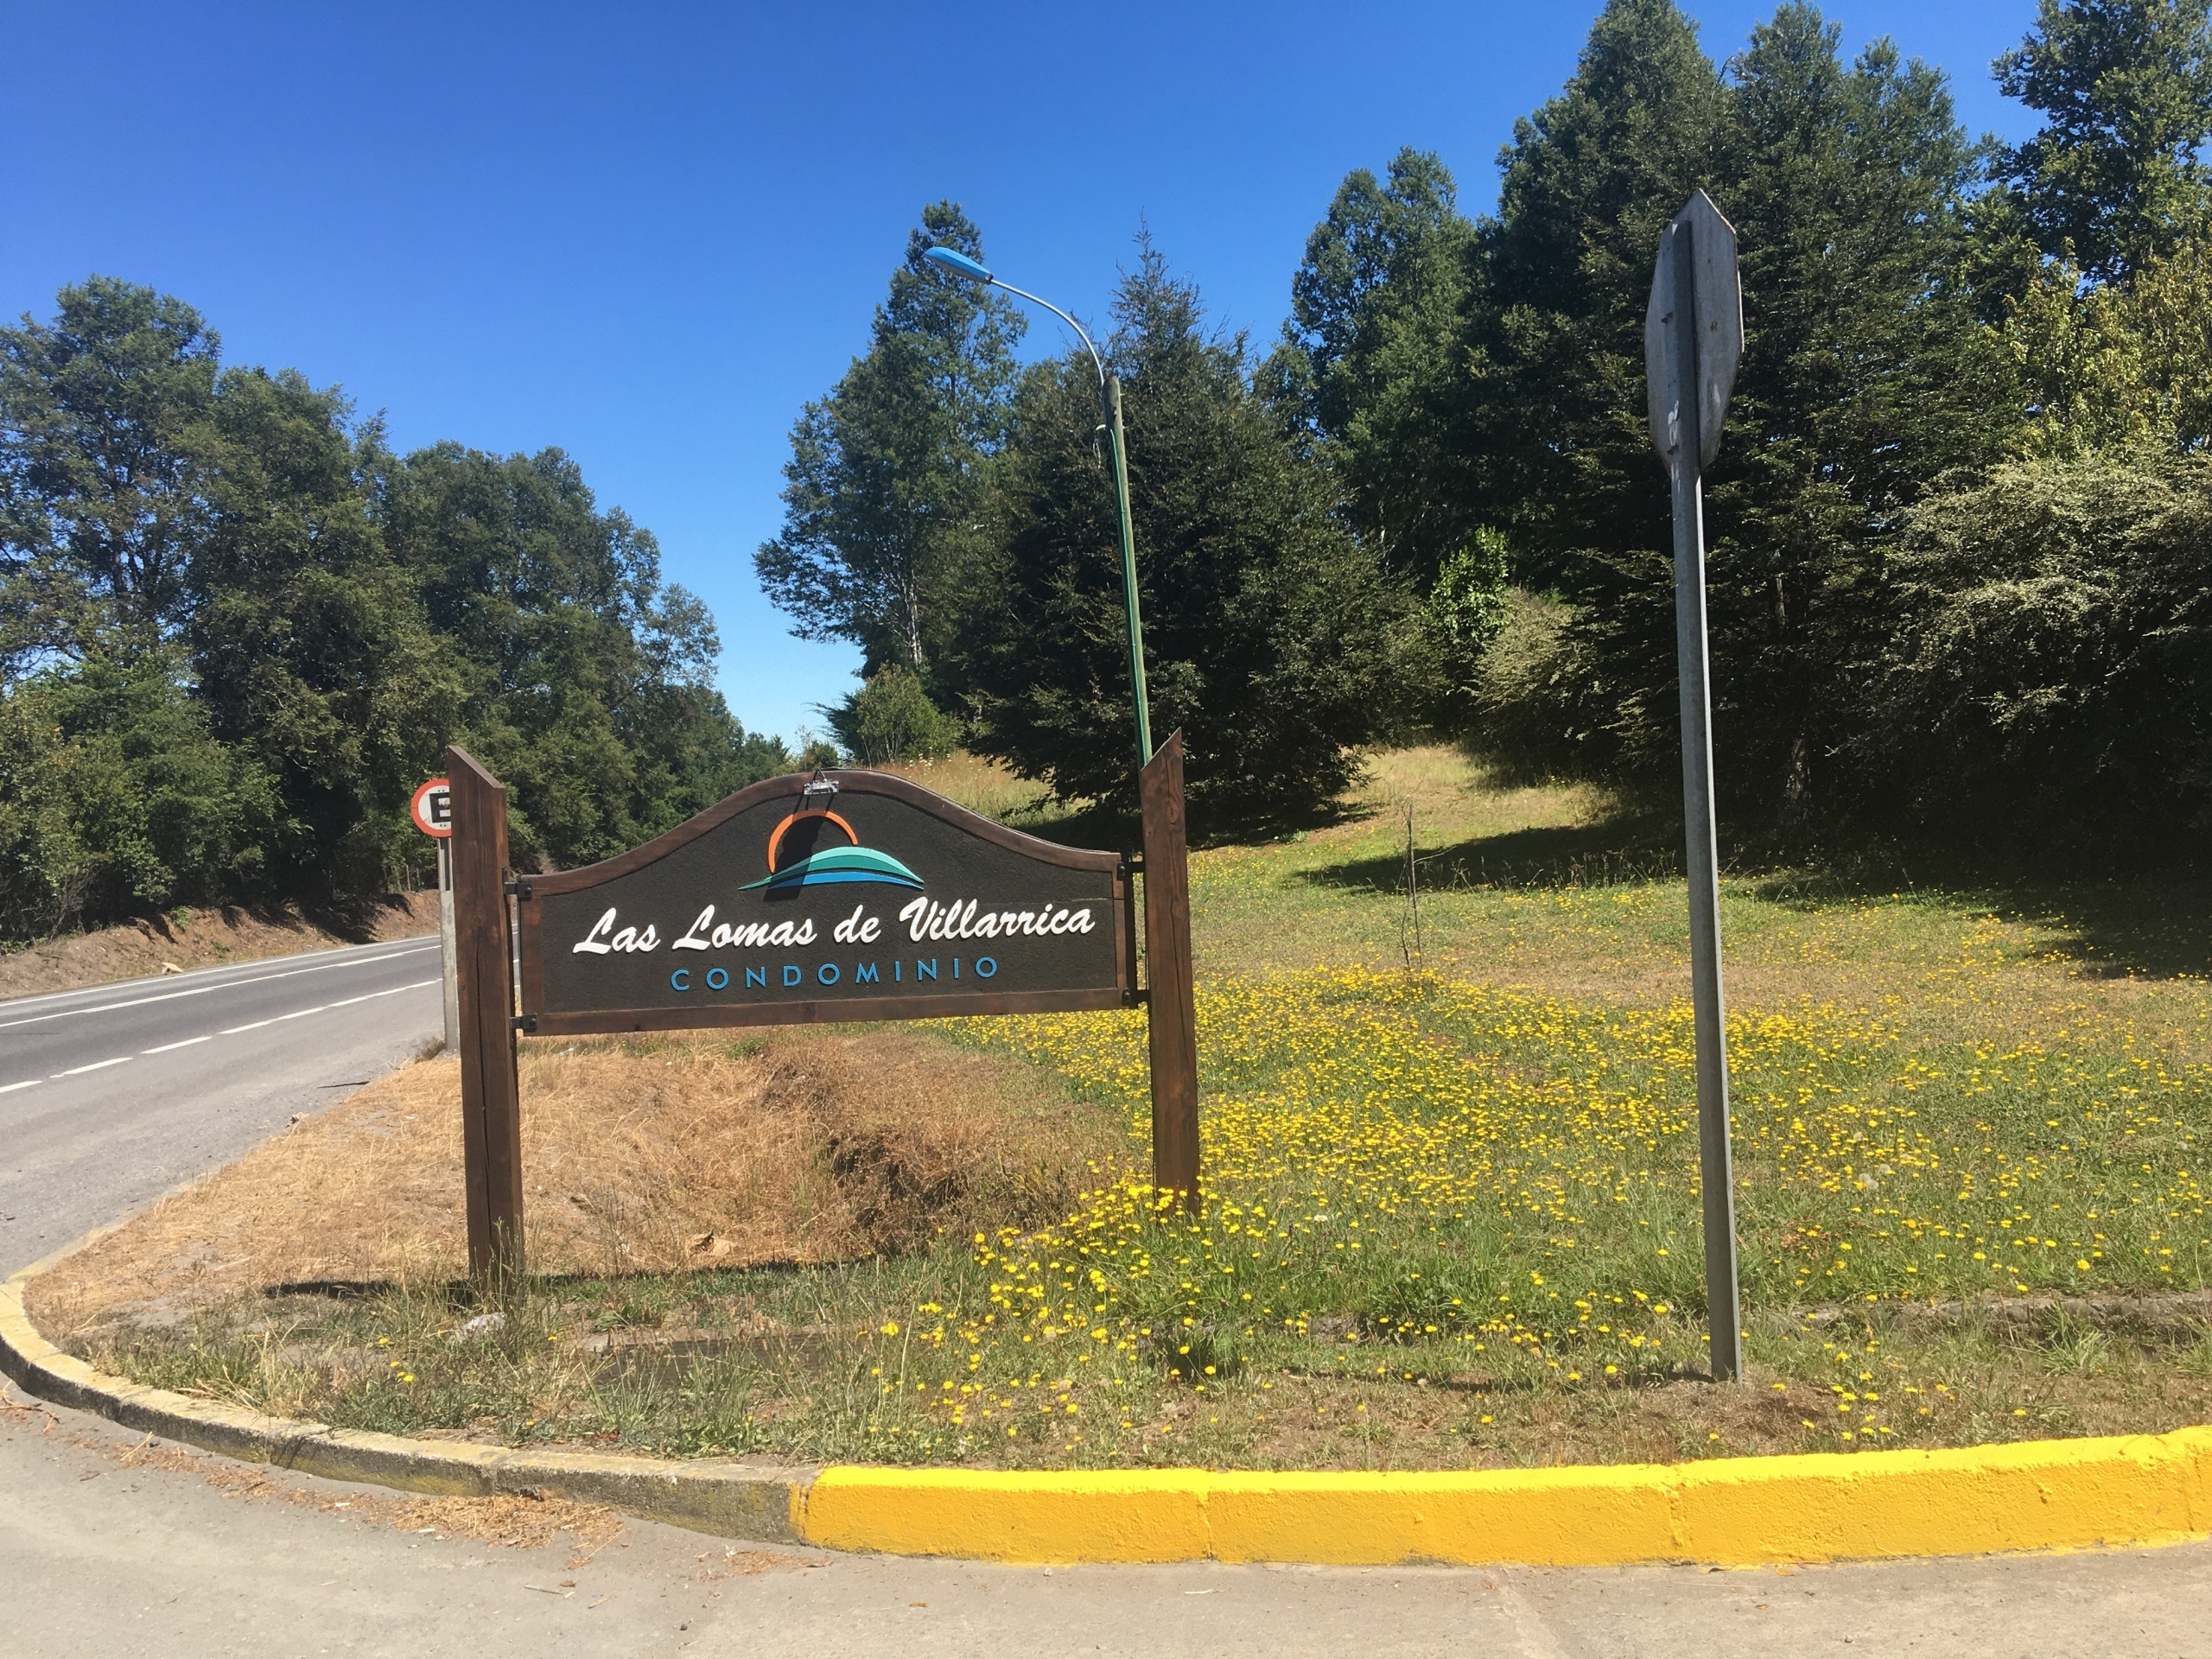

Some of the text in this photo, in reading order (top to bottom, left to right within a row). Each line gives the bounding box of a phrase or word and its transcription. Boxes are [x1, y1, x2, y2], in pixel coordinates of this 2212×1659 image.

[429, 792, 451, 823] E
[572, 896, 1096, 955] Las Lomas de Villarrica
[671, 957, 998, 992] CONDOMINIO
